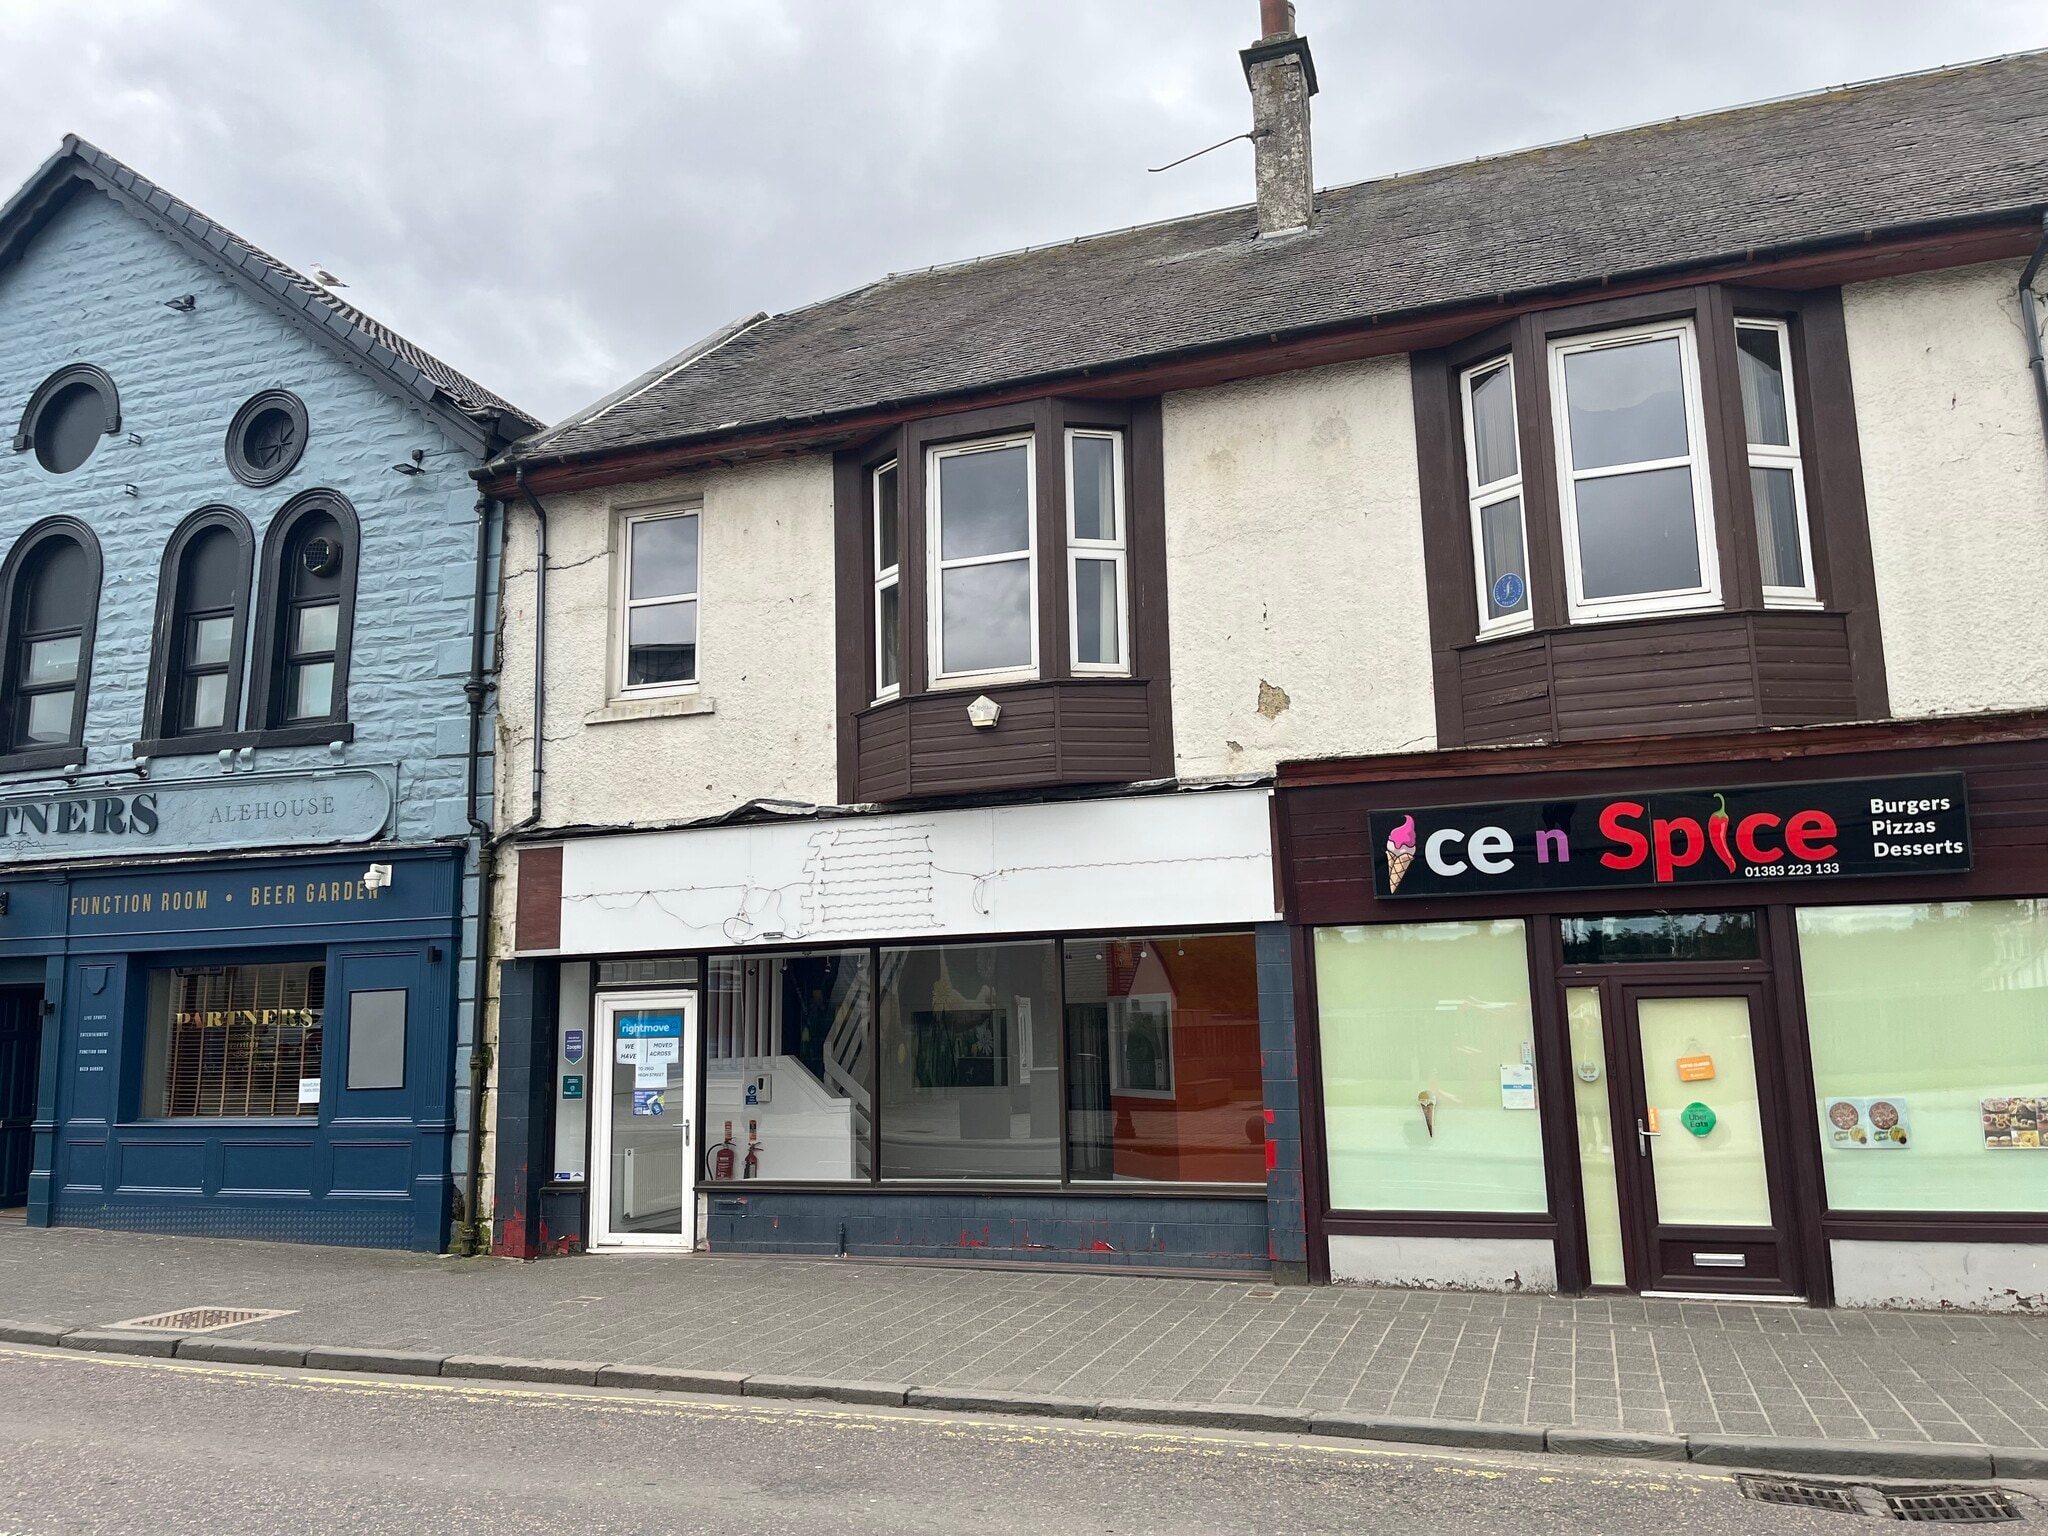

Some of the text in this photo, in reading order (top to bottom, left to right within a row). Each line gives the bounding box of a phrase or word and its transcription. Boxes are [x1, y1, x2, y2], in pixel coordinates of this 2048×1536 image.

[208, 797, 335, 823] ALEHOUSE
[1870, 798, 1950, 815] Burgers
[1871, 820, 1936, 836] Pizzas
[1535, 829, 1570, 863] n
[1873, 840, 1963, 857] Desserts
[1744, 863, 1840, 877] 01383 223 133
[71, 881, 379, 916] FUNCTION ROOM BEER GARDEN
[176, 1008, 313, 1028] PARTNERS
[622, 1024, 669, 1035] rightmove
